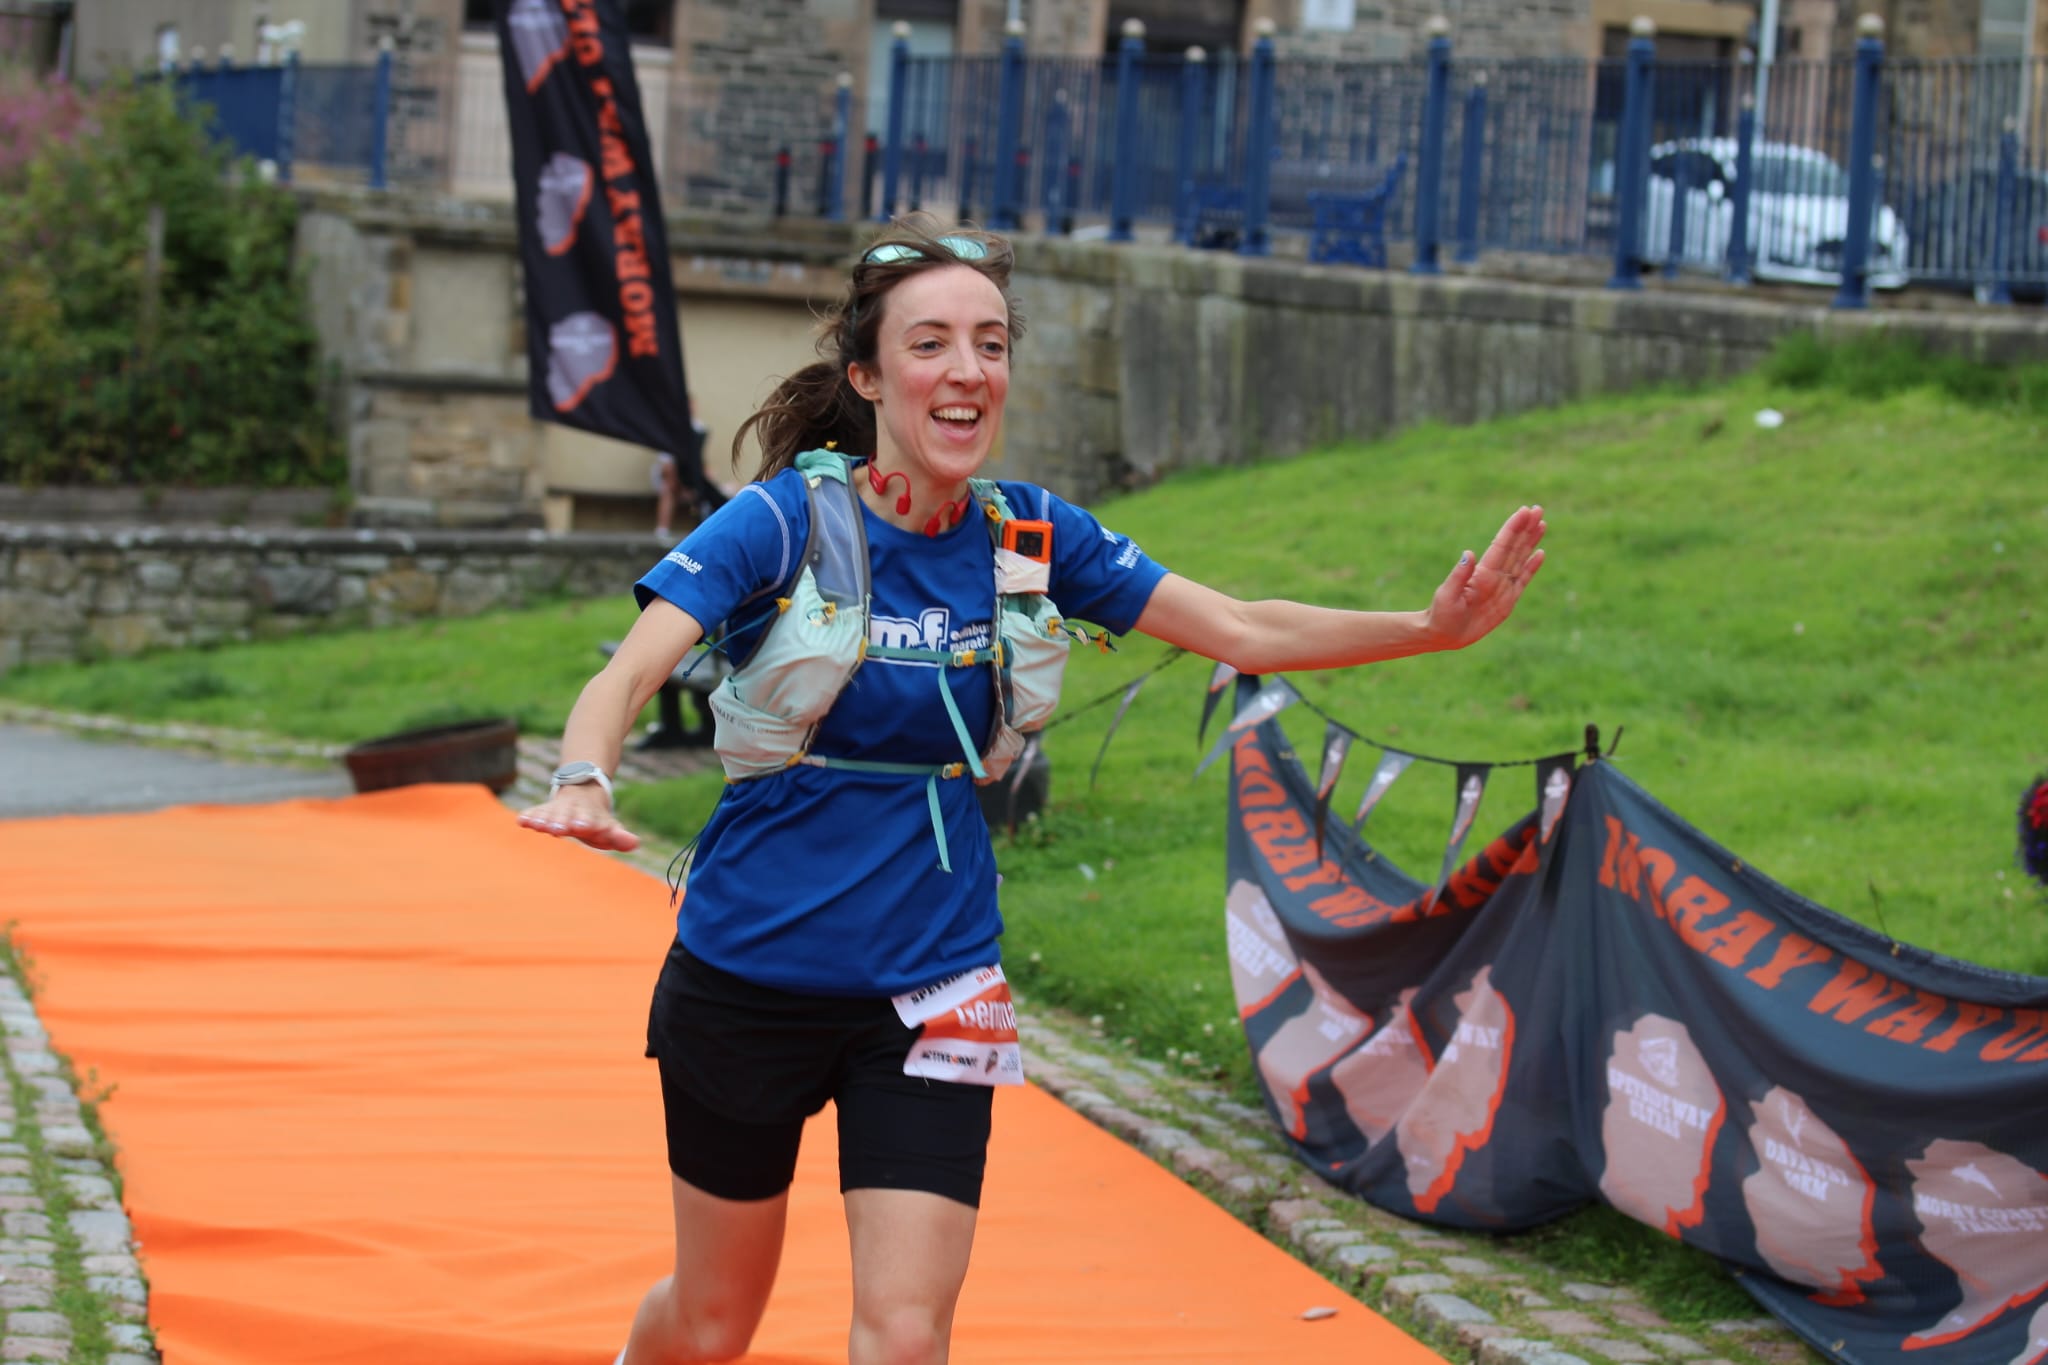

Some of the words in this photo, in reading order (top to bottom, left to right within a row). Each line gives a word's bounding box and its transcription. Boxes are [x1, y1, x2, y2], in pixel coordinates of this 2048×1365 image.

[606, 187, 659, 356] MORAY
[1599, 814, 1833, 990] MORAY
[1808, 958, 2003, 1053] WAY
